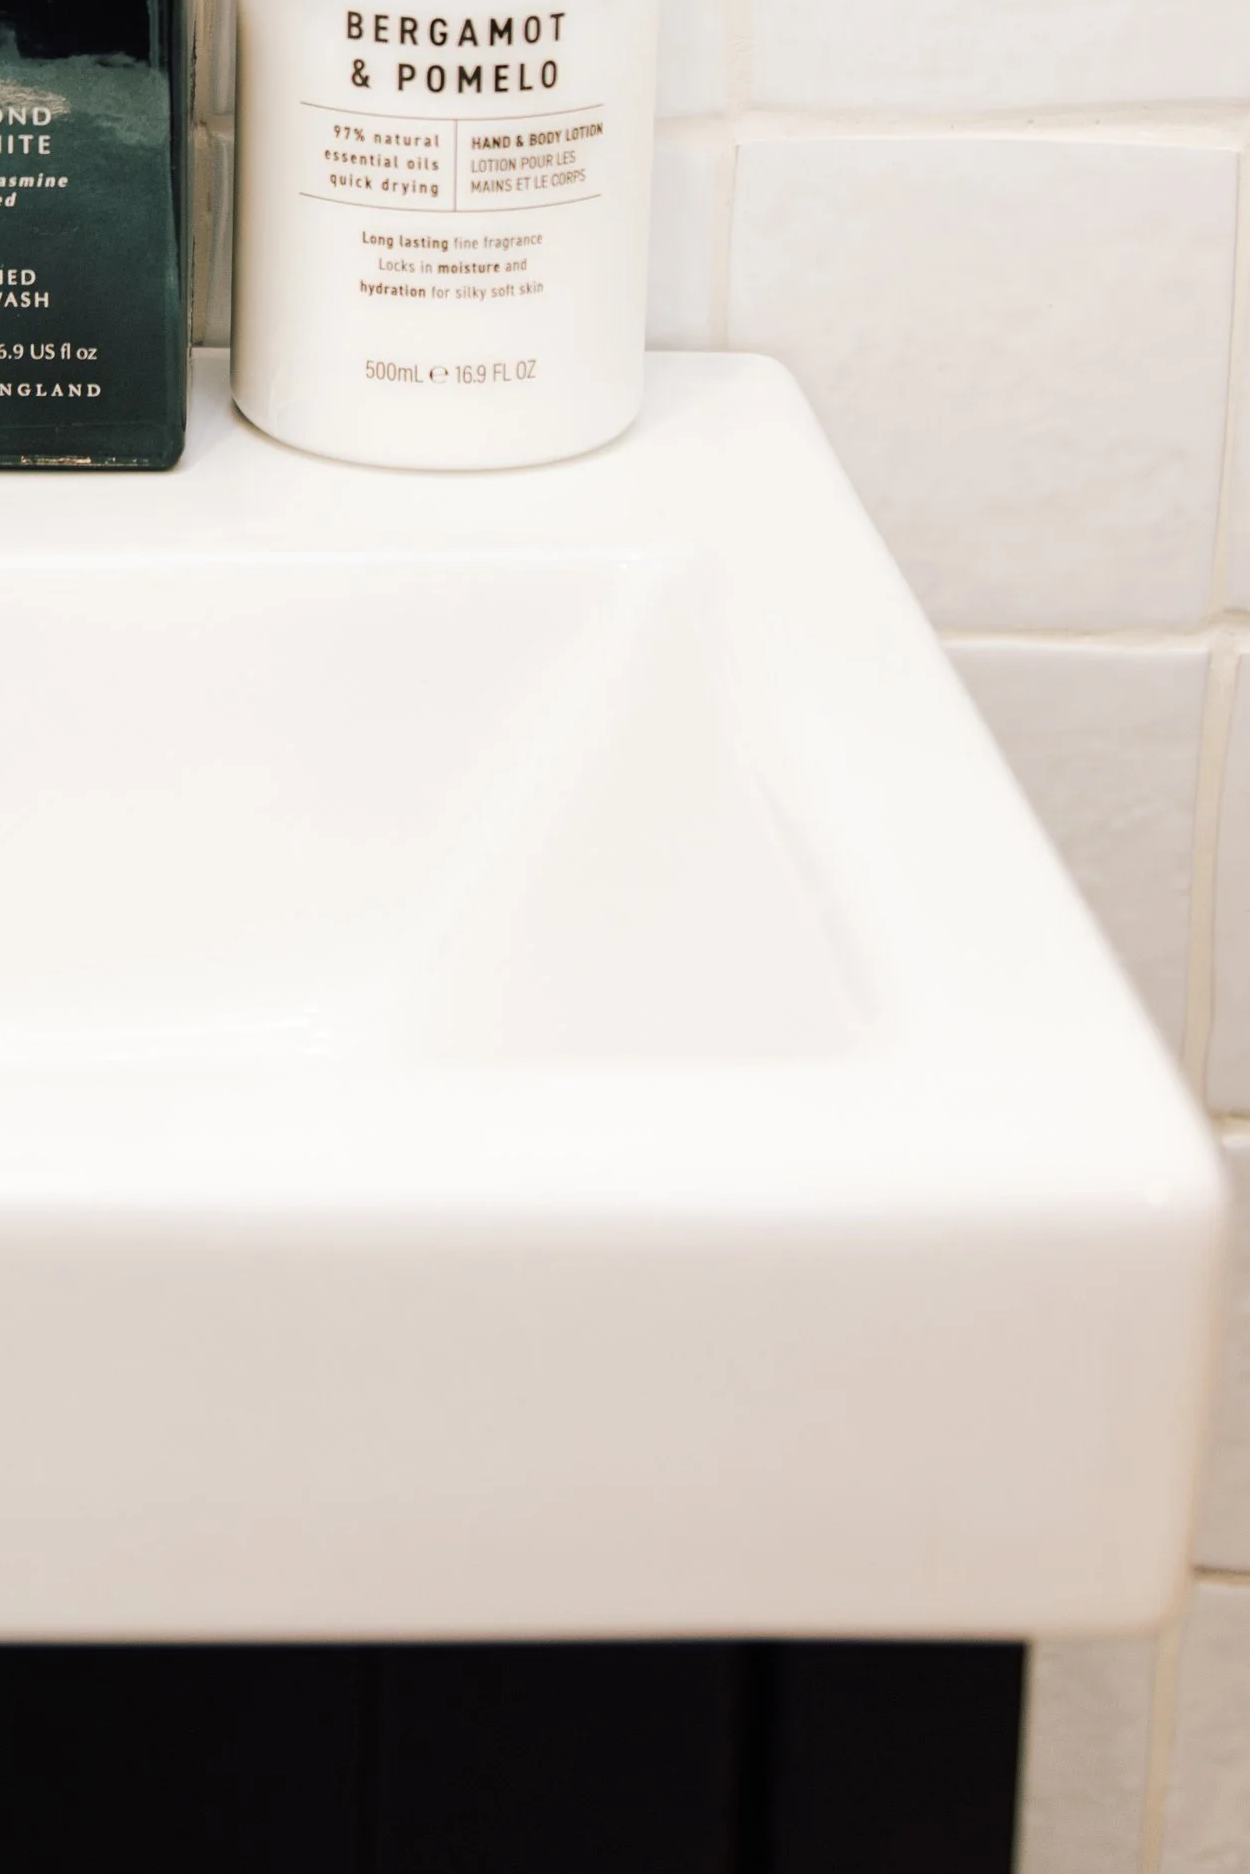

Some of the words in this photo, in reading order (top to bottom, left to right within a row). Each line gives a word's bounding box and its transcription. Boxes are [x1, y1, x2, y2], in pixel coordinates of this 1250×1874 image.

[346, 11, 566, 47] BERGAMOT
[350, 59, 370, 88] &
[398, 60, 558, 93] POMELO
[333, 124, 365, 143] 97%
[373, 131, 439, 148] natural
[471, 135, 511, 150] HAND
[515, 133, 525, 148] &
[529, 129, 562, 147] BODY
[565, 122, 604, 143] LOTION
[324, 148, 399, 169] essential
[406, 156, 439, 171] oils
[470, 158, 517, 173] LOTION
[520, 153, 553, 171] POUR
[556, 150, 576, 166] LES
[329, 172, 373, 191] quick
[381, 178, 439, 197] drying
[470, 178, 513, 195] MAINS
[516, 177, 530, 191] ET
[534, 174, 548, 189] LE
[551, 169, 586, 187] CORPS
[362, 231, 395, 249] Long
[399, 234, 448, 252] lasting
[453, 237, 479, 250] fine
[483, 233, 543, 251] fragrance
[378, 258, 416, 274] Locks
[420, 260, 433, 274] in
[437, 260, 500, 274] moisture
[505, 258, 528, 272] and
[359, 280, 426, 299] hydration
[431, 285, 450, 299] for
[455, 284, 487, 301] silky
[491, 283, 515, 298] soft
[520, 280, 544, 295] skin
[30, 343, 56, 360] US
[60, 343, 72, 360] fl
[75, 347, 98, 361] oz
[365, 360, 424, 384] 500mL
[455, 364, 487, 384] 16.9
[493, 363, 511, 382] FL
[516, 360, 536, 380] OZ
